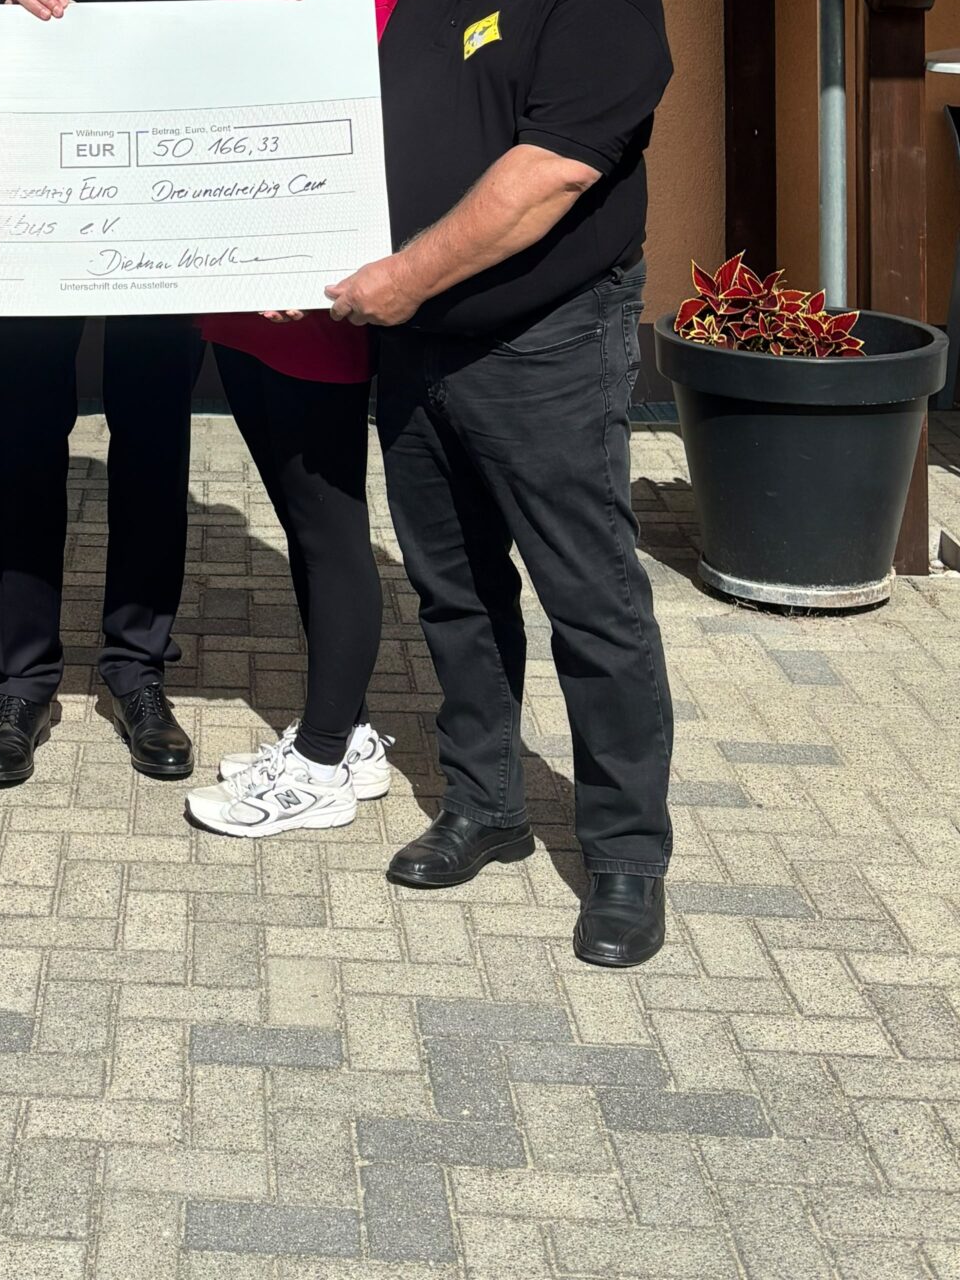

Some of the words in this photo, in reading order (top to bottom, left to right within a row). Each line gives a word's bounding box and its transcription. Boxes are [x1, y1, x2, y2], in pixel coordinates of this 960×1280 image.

[76, 128, 115, 139] Währung
[210, 125, 231, 133] Cent
[76, 143, 115, 158] EUR
[79, 177, 119, 201] Euro
[60, 281, 111, 292] Unterschrift
[113, 281, 129, 290] des
[130, 280, 179, 290] Ausstellers
